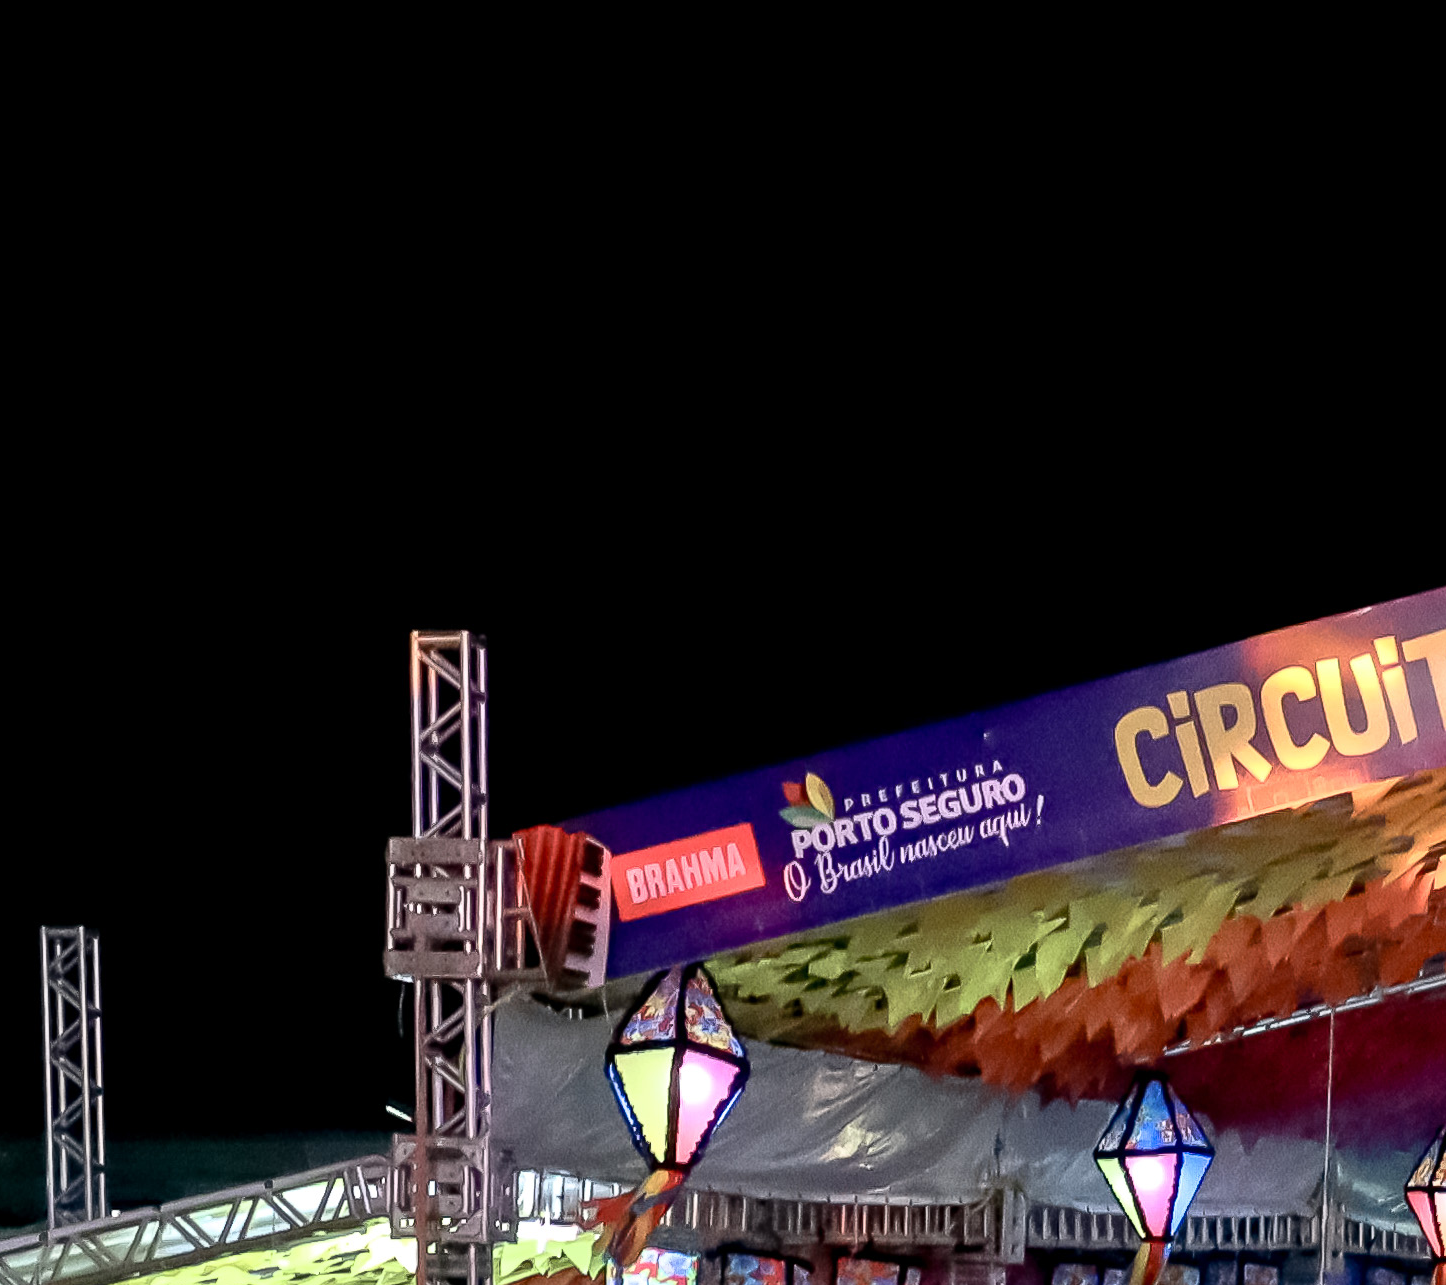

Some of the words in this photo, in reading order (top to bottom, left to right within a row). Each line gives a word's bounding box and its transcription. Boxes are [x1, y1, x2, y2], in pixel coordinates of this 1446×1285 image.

[791, 806, 898, 859] PORTO
[899, 773, 1027, 830] SEGURO
[843, 759, 1004, 812] PREFEITURA
[625, 842, 747, 905] BRAHMA
[783, 860, 812, 903] O
[814, 835, 895, 895] Brasil
[900, 824, 975, 865] nasceu
